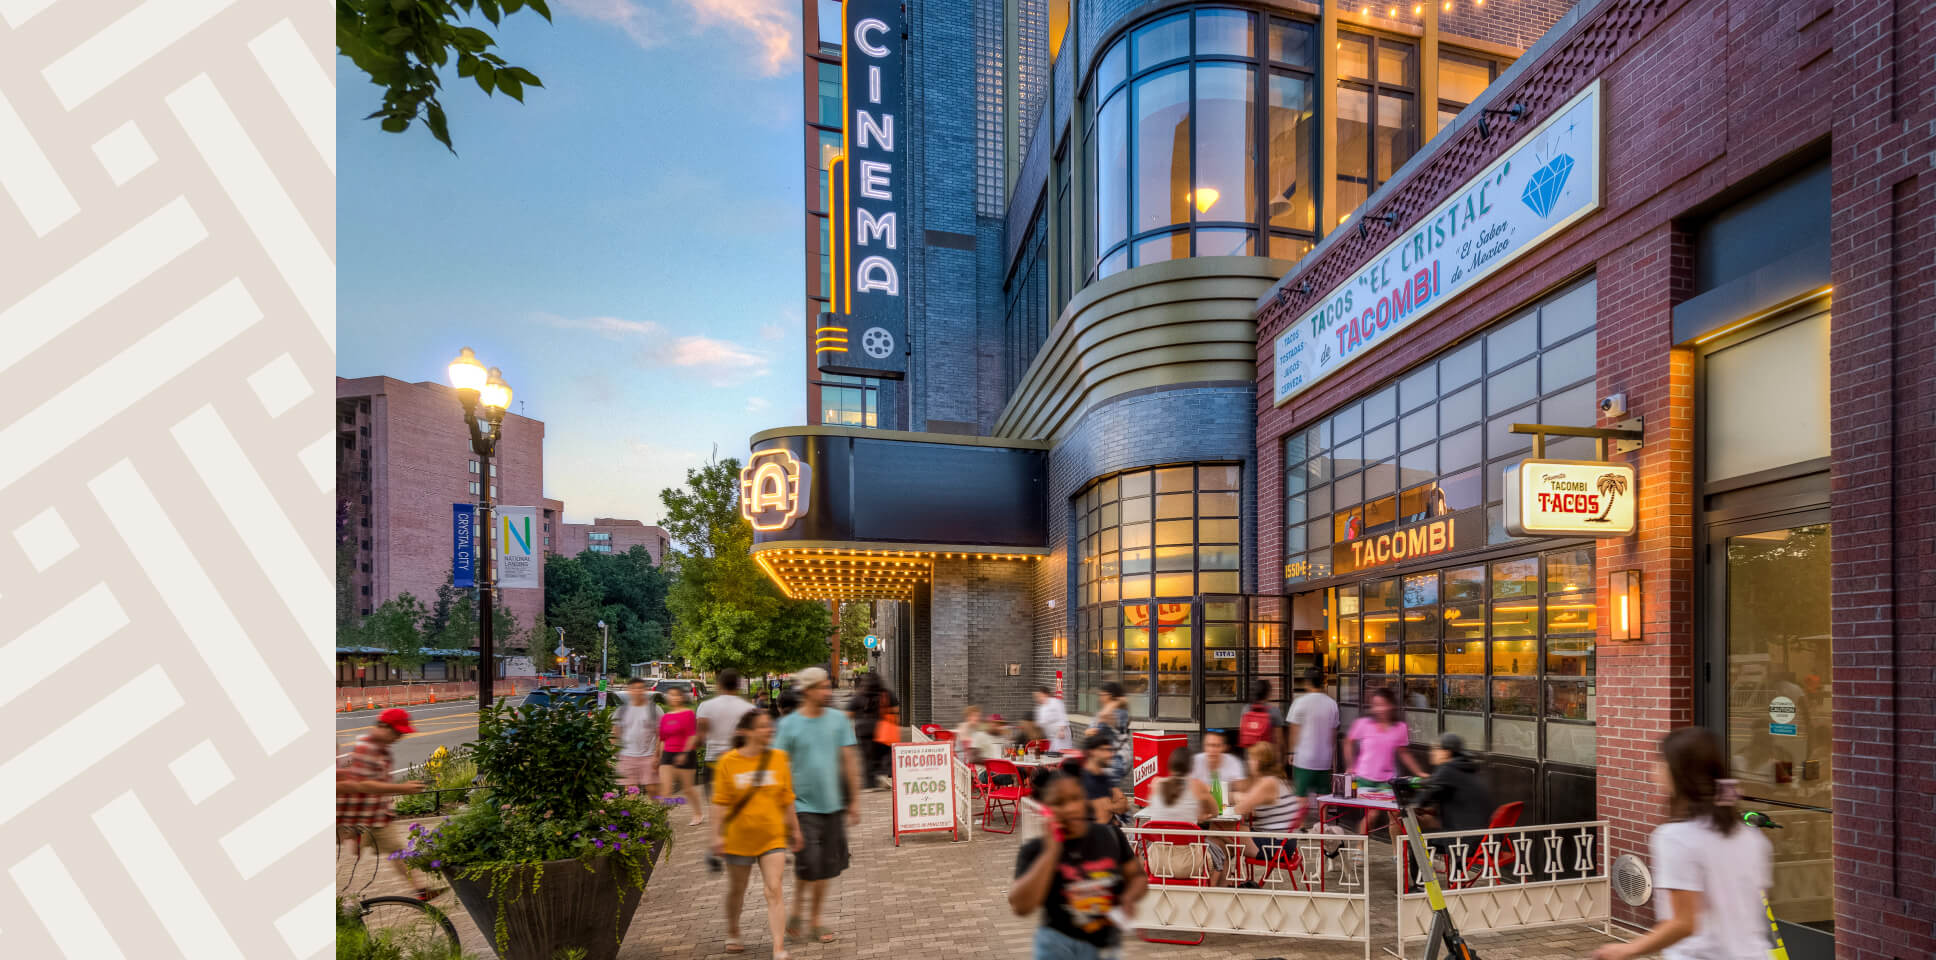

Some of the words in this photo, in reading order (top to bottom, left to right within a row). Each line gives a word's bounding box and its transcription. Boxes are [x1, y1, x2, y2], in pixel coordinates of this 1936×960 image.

[854, 18, 899, 296] CINEMA
[1476, 221, 1508, 249] Sabor
[1451, 266, 1463, 284] de
[1311, 290, 1353, 338] TACOS
[1321, 344, 1331, 365] de
[1336, 259, 1440, 357] TACOMBI
[1280, 342, 1304, 365] TOSTADAS
[1280, 375, 1303, 395] CERVEZA
[1551, 481, 1588, 492] TACOMBI
[1538, 493, 1599, 514] TACOS
[458, 513, 469, 550] CRYSTAL
[1352, 518, 1455, 568] TACOMBI
[458, 551, 469, 571] CITY
[898, 753, 948, 769] TACOMBI
[903, 780, 947, 794] TACOS
[909, 802, 945, 817] BEER
